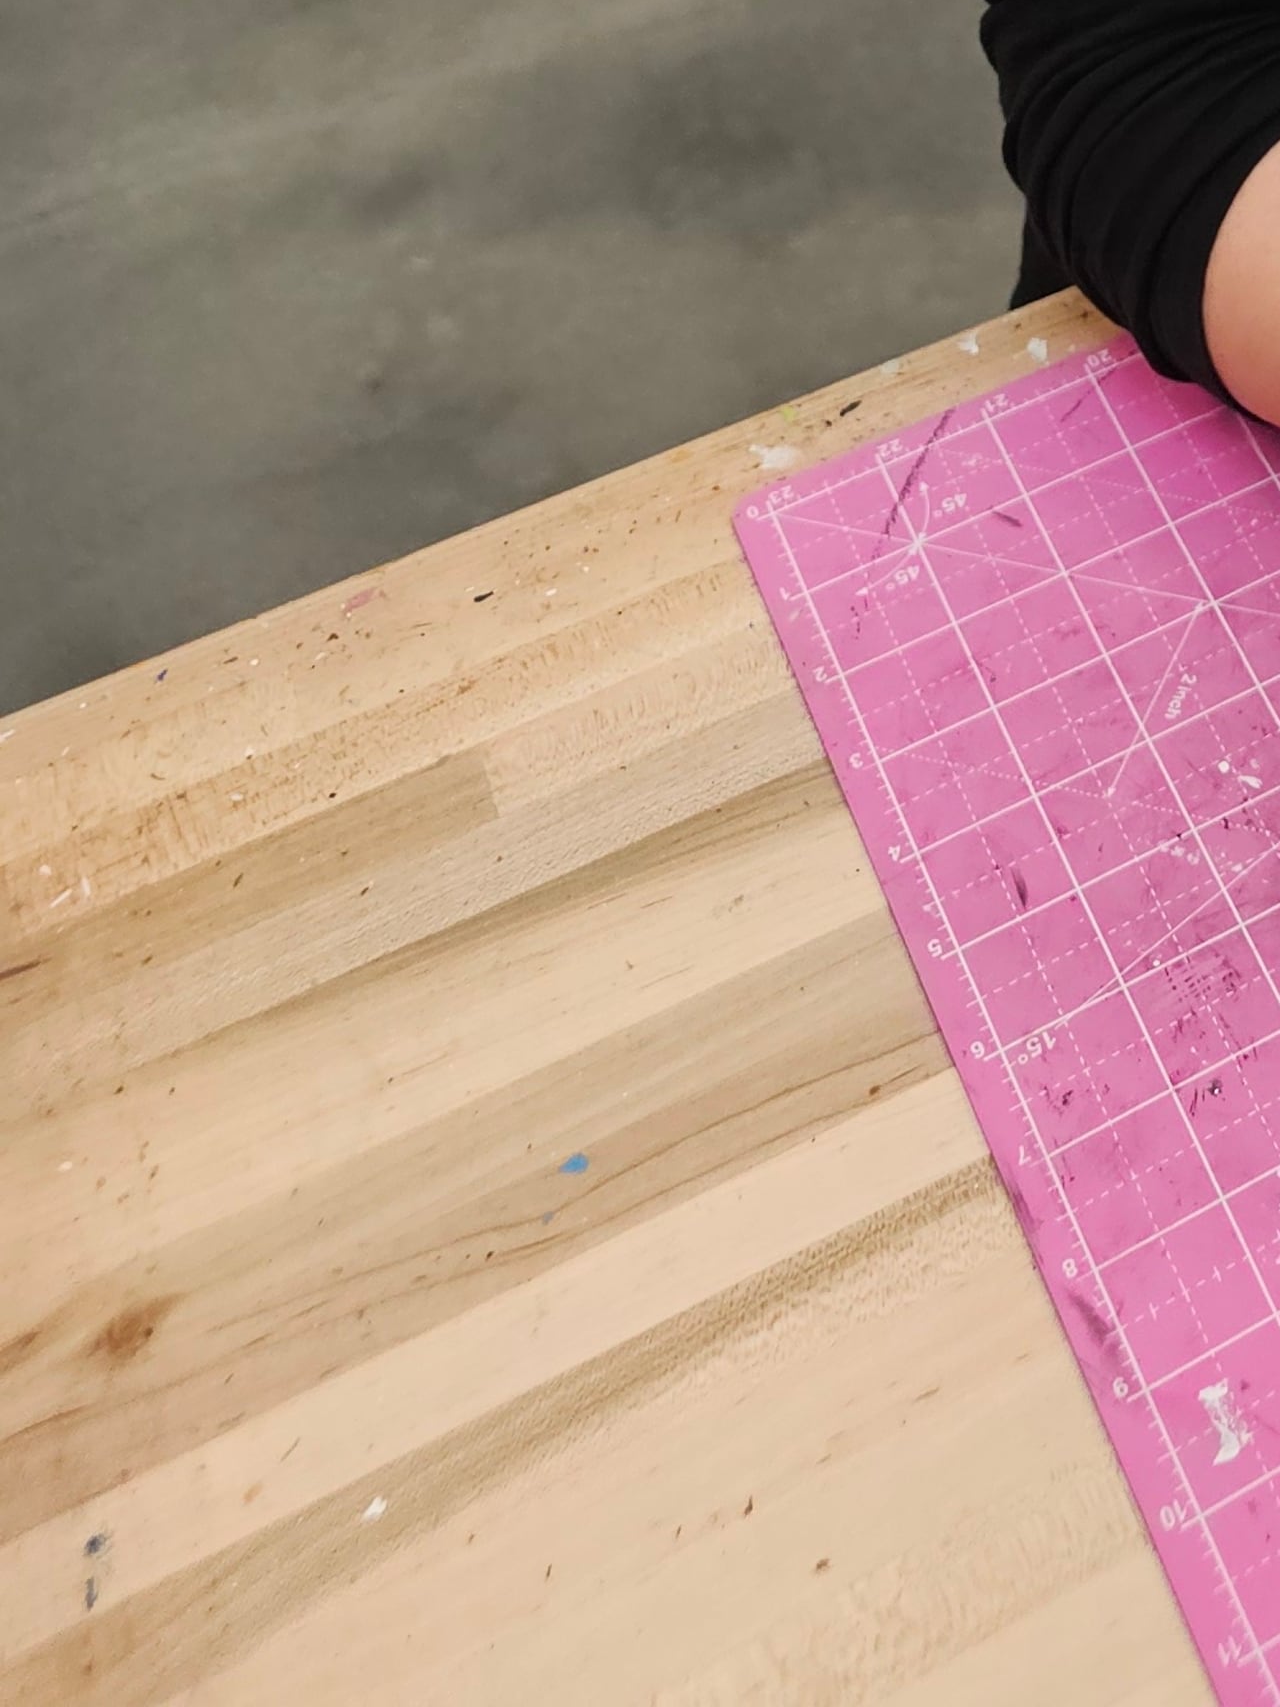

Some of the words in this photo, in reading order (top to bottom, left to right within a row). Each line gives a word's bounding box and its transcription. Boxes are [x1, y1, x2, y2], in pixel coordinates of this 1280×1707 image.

[1087, 348, 1111, 368] 20
[985, 392, 1009, 416] 21
[877, 437, 903, 460] 22
[769, 484, 794, 504] 23
[746, 506, 760, 520] 0
[934, 492, 968, 518] 45°
[884, 563, 921, 592] 45°
[812, 666, 828, 684] 2
[1180, 673, 1198, 684] 2
[848, 753, 864, 770] 3
[887, 843, 902, 862] 4
[927, 938, 943, 957] 5
[969, 1040, 985, 1059] 6
[1017, 1031, 1057, 1066] 15°
[1062, 1258, 1078, 1279] 8
[1112, 1376, 1129, 1399] 9
[1160, 1497, 1188, 1529] 10
